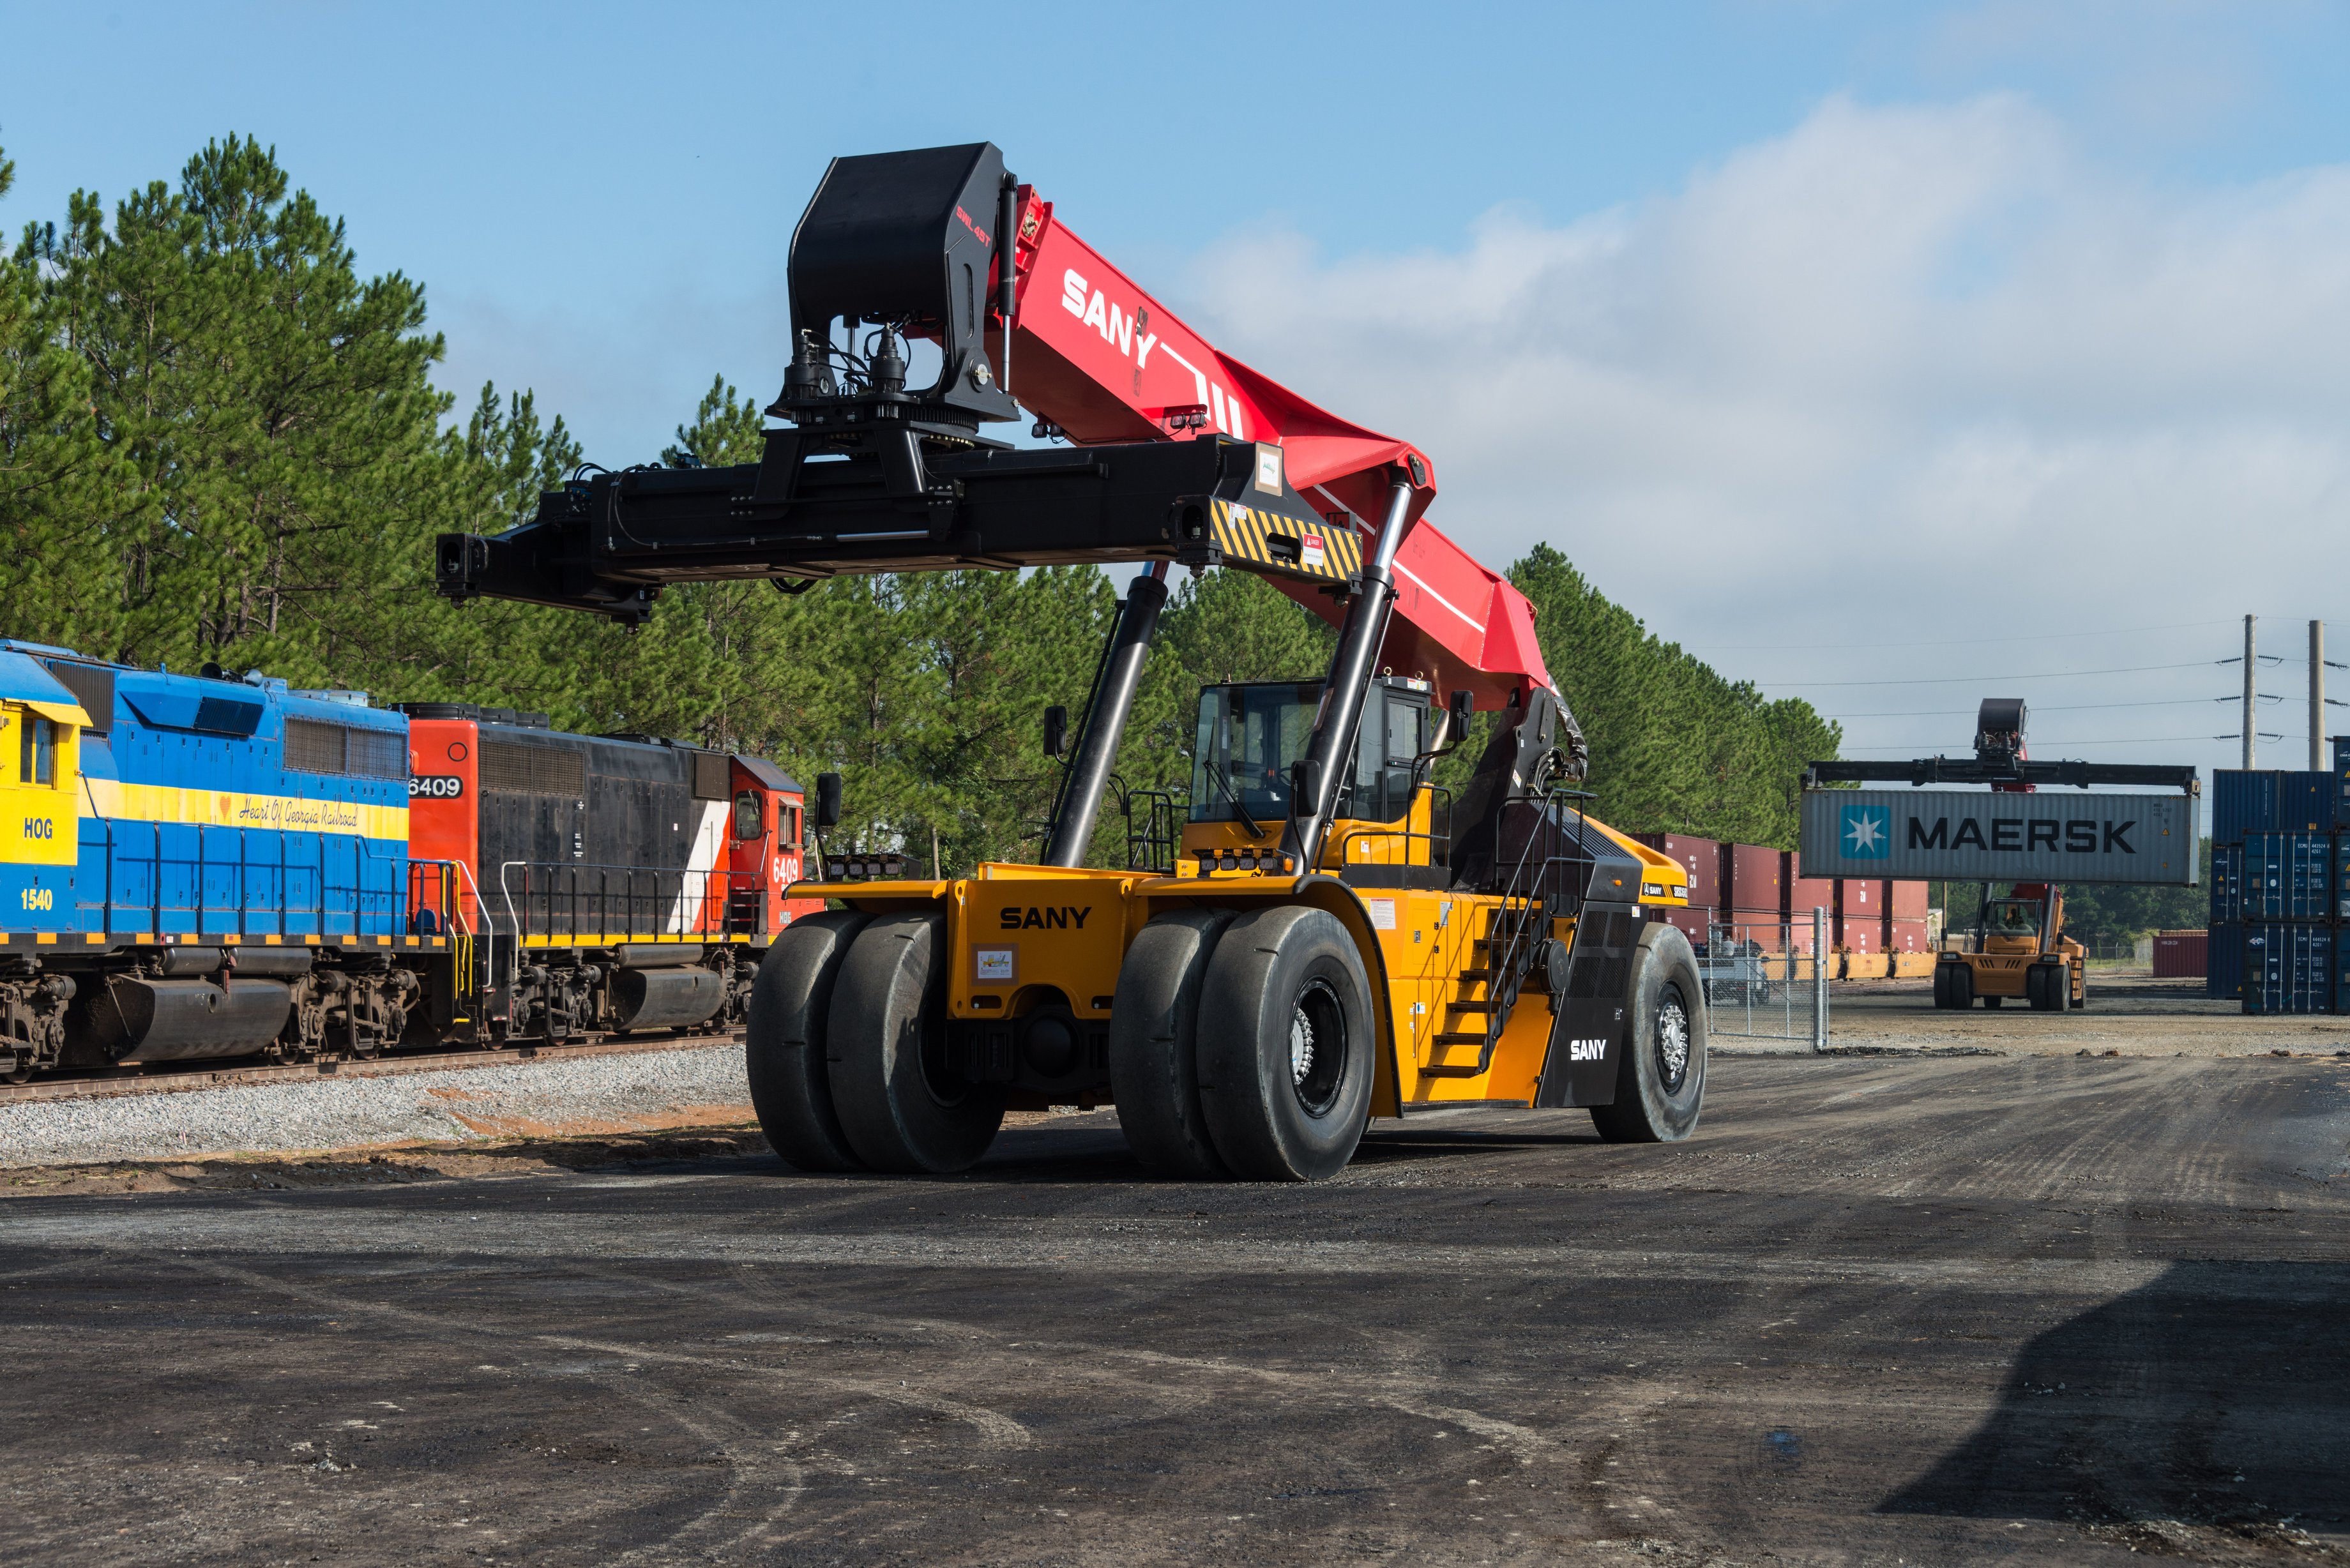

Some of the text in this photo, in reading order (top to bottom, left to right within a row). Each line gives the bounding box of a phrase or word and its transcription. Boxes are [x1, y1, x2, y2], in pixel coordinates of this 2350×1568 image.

[956, 205, 991, 248] SWL 45T
[1061, 268, 1158, 370] SANY
[409, 778, 460, 796] 6409
[239, 796, 358, 831] Heart Of Georgia Railroad
[24, 817, 53, 840] HOG
[1908, 817, 2137, 854] MAERSK
[773, 857, 798, 884] 6409
[21, 889, 53, 911] 1540
[1649, 886, 1662, 895] SANY
[780, 911, 791, 924] HOG
[1000, 907, 1092, 930] SANY
[1570, 1039, 1607, 1061] SANY
